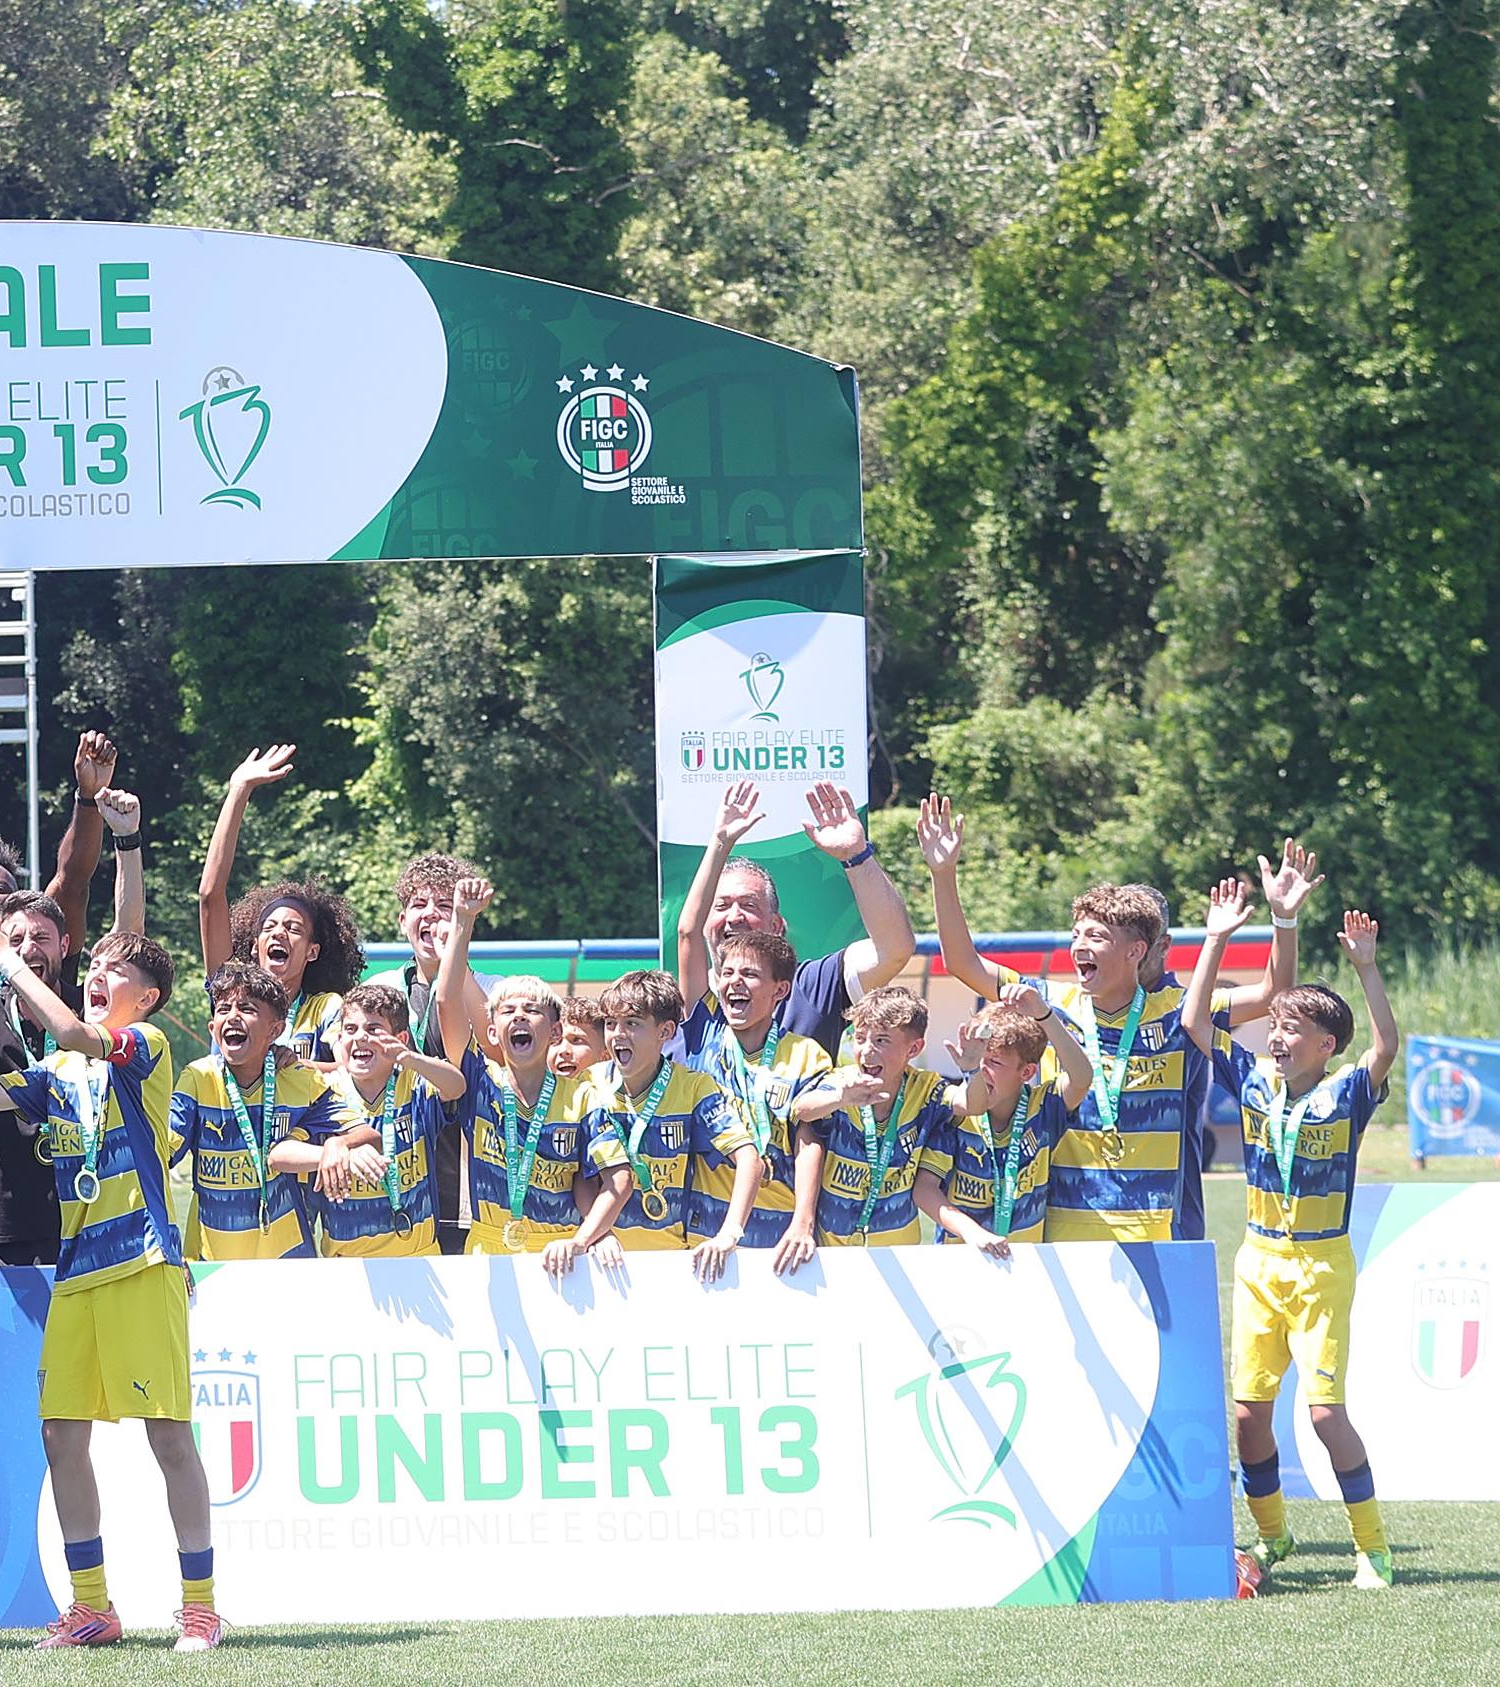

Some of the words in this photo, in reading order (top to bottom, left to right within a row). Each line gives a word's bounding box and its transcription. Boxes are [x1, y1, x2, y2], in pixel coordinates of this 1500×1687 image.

[9, 380, 127, 421] ELITE
[581, 419, 628, 440] FIGC
[54, 423, 128, 486] 13
[631, 477, 668, 487] SETTORE
[631, 486, 676, 496] GIOVANILE
[679, 486, 684, 494] E
[631, 495, 686, 505] SCOLASTICO
[712, 732, 748, 747] FAIR
[754, 730, 795, 746] PLAY
[800, 729, 845, 746] ELITE
[713, 746, 807, 771] UNDER
[817, 745, 845, 769] 13
[681, 773, 724, 783] SETTORE
[787, 771, 846, 781] SCOLASTICO
[537, 1075, 556, 1112] FINALE
[1012, 1093, 1029, 1133] FINALE
[526, 1114, 545, 1144] 2026
[1008, 1138, 1020, 1169] 2026
[294, 1352, 428, 1410] FAIR
[459, 1347, 614, 1406] PLAY
[644, 1343, 817, 1402] ELITE
[192, 1383, 253, 1407] ALIA
[297, 1408, 671, 1505] UNDER
[711, 1405, 820, 1496] 13
[351, 1512, 549, 1549] GIOVANILE
[565, 1512, 583, 1544] E
[598, 1507, 825, 1544] SCOLASTICO
